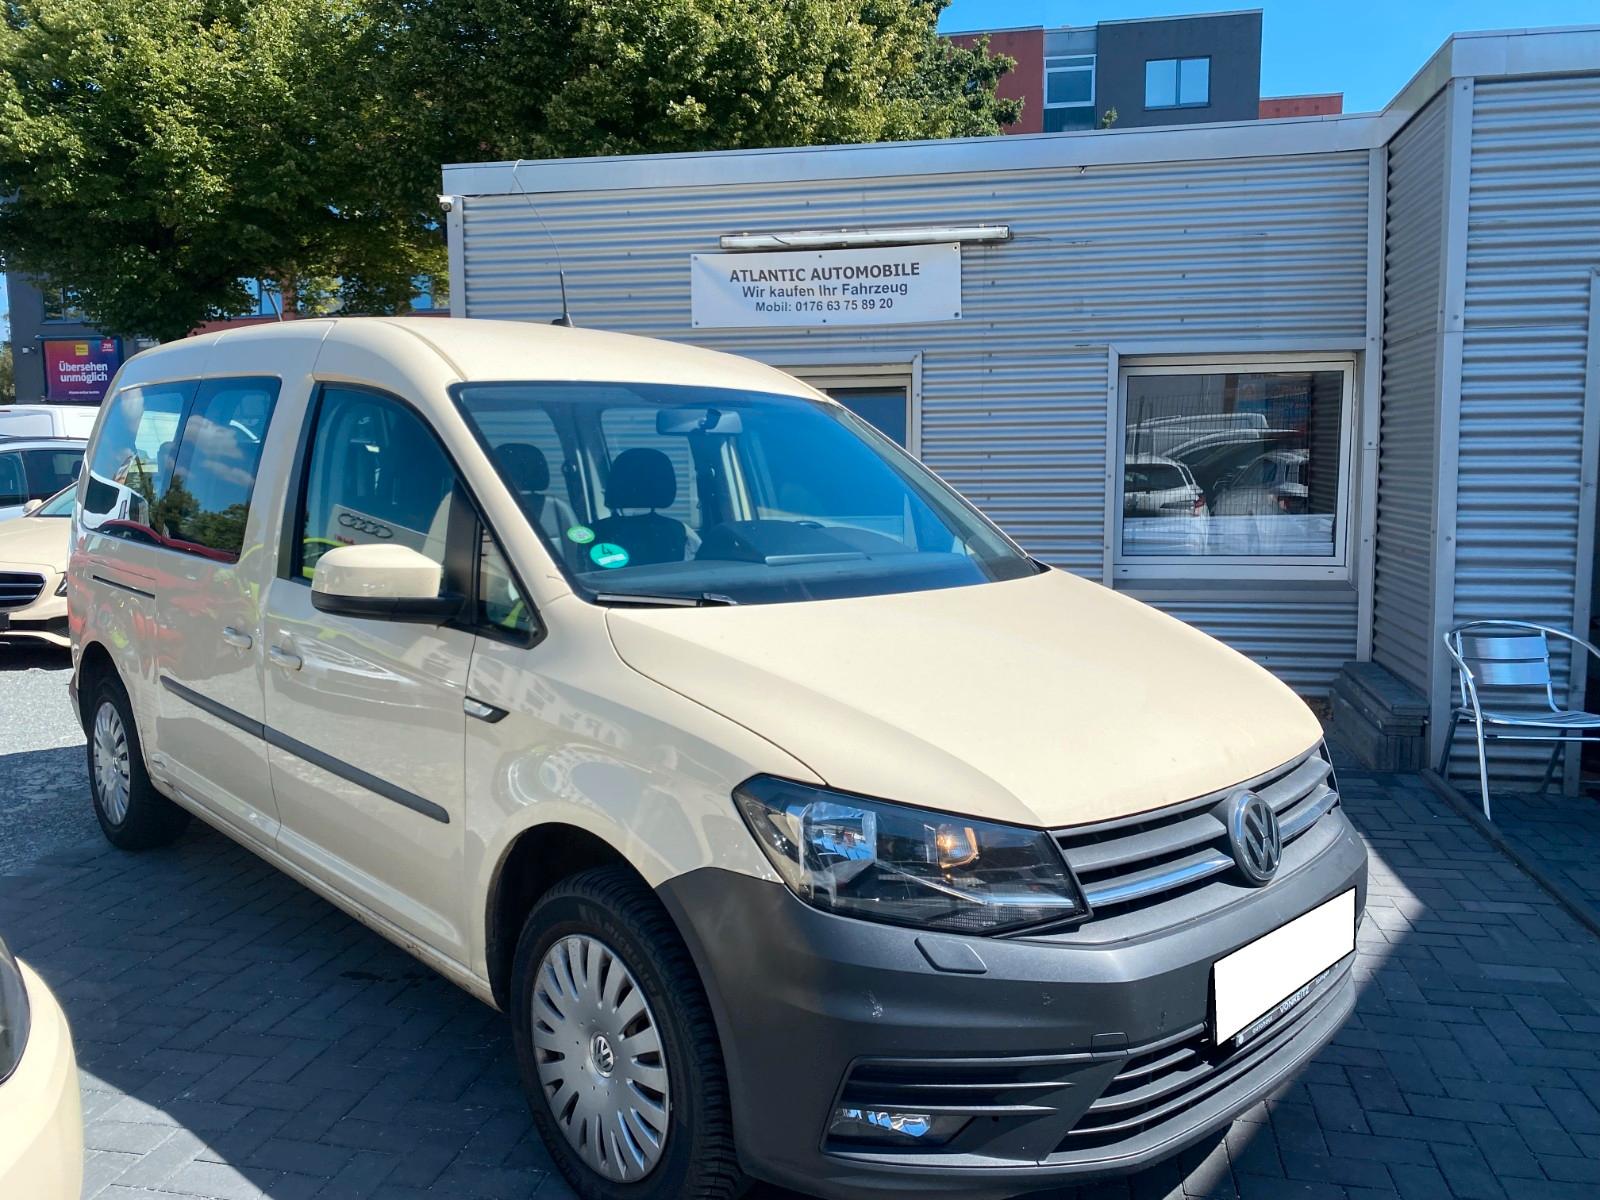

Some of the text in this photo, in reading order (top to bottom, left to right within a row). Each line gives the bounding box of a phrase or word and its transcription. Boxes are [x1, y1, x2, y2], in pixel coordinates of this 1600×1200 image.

[729, 262, 920, 283] ATLANTIC AUTOMOBILE
[742, 281, 909, 298] Wir kaufen Ihr Fahrzeug
[755, 298, 893, 312] Mobil: 0176 63 75 89 20
[59, 361, 108, 372] Übersehen
[60, 372, 108, 383] unmöglich
